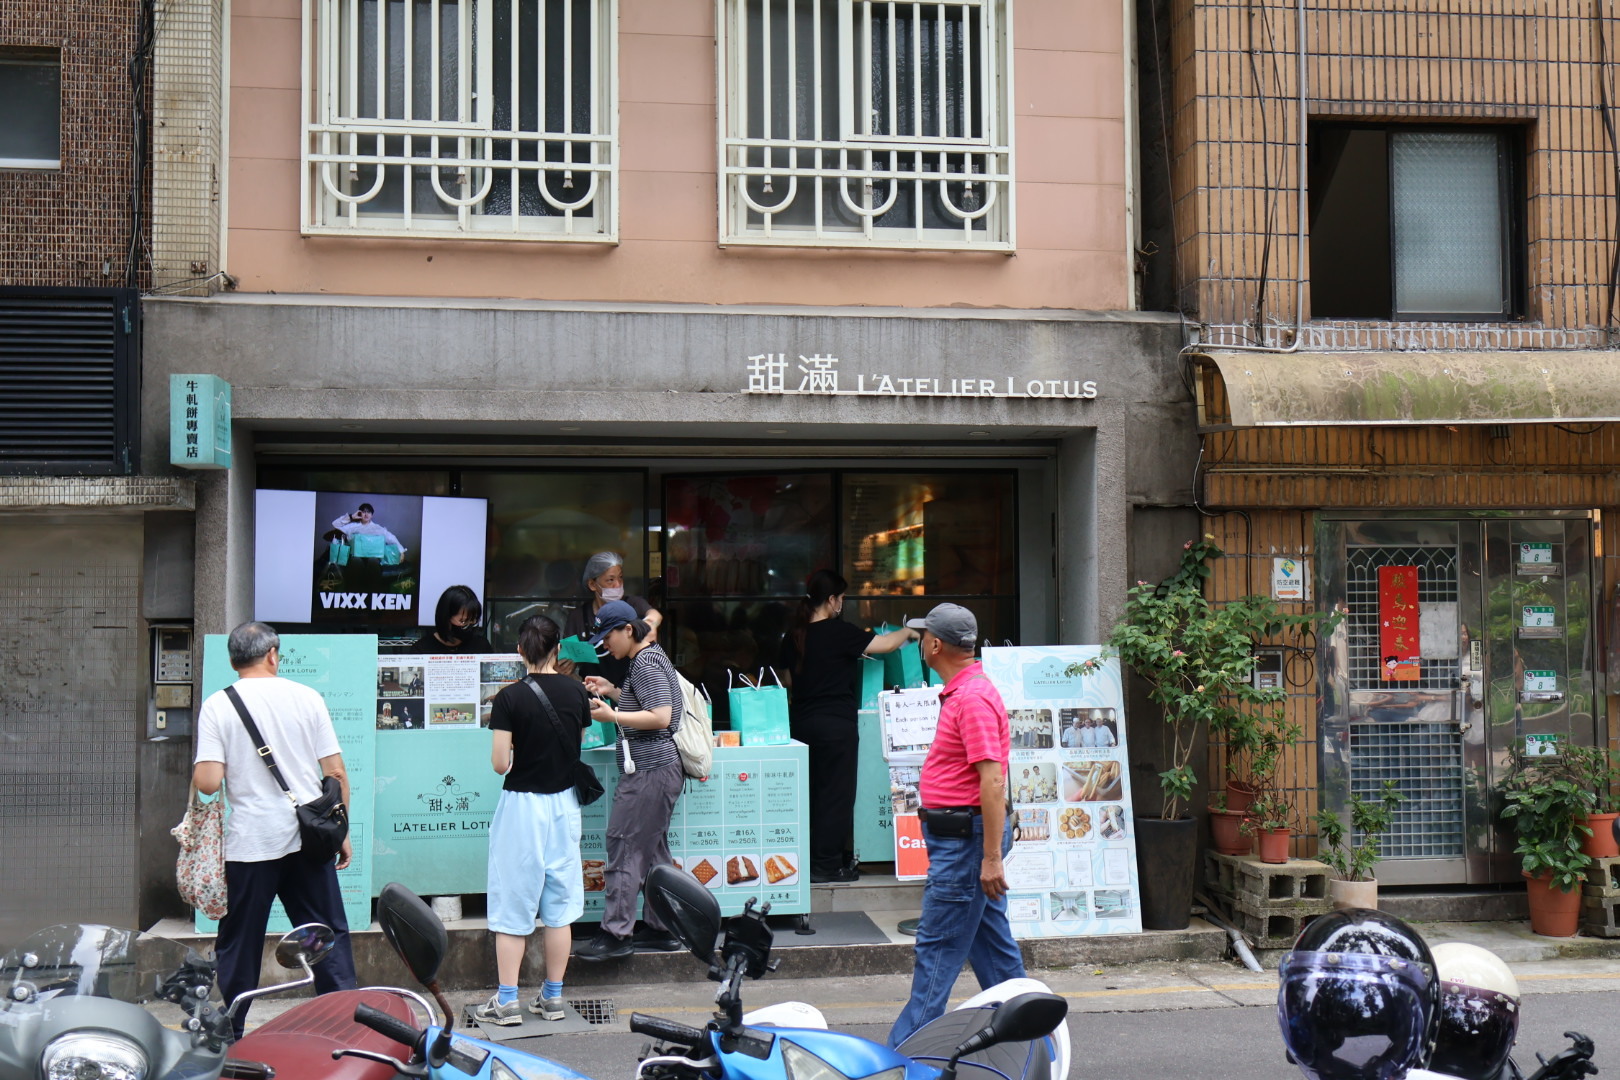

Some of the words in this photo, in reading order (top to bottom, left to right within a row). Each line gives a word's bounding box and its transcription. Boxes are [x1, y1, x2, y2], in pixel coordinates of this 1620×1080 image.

[746, 353, 839, 393] 甜滿
[857, 373, 997, 397] L'ATELIER
[1007, 375, 1098, 399] LOTUS
[186, 380, 198, 458] 牛軋餅專賣店
[1534, 553, 1540, 562] 8
[319, 592, 368, 609] VIXX
[371, 593, 412, 610] KEN
[1536, 617, 1542, 625] 8
[1538, 681, 1543, 689] 8
[428, 796, 469, 812] 甜滿
[393, 822, 457, 833] L'ATELIER
